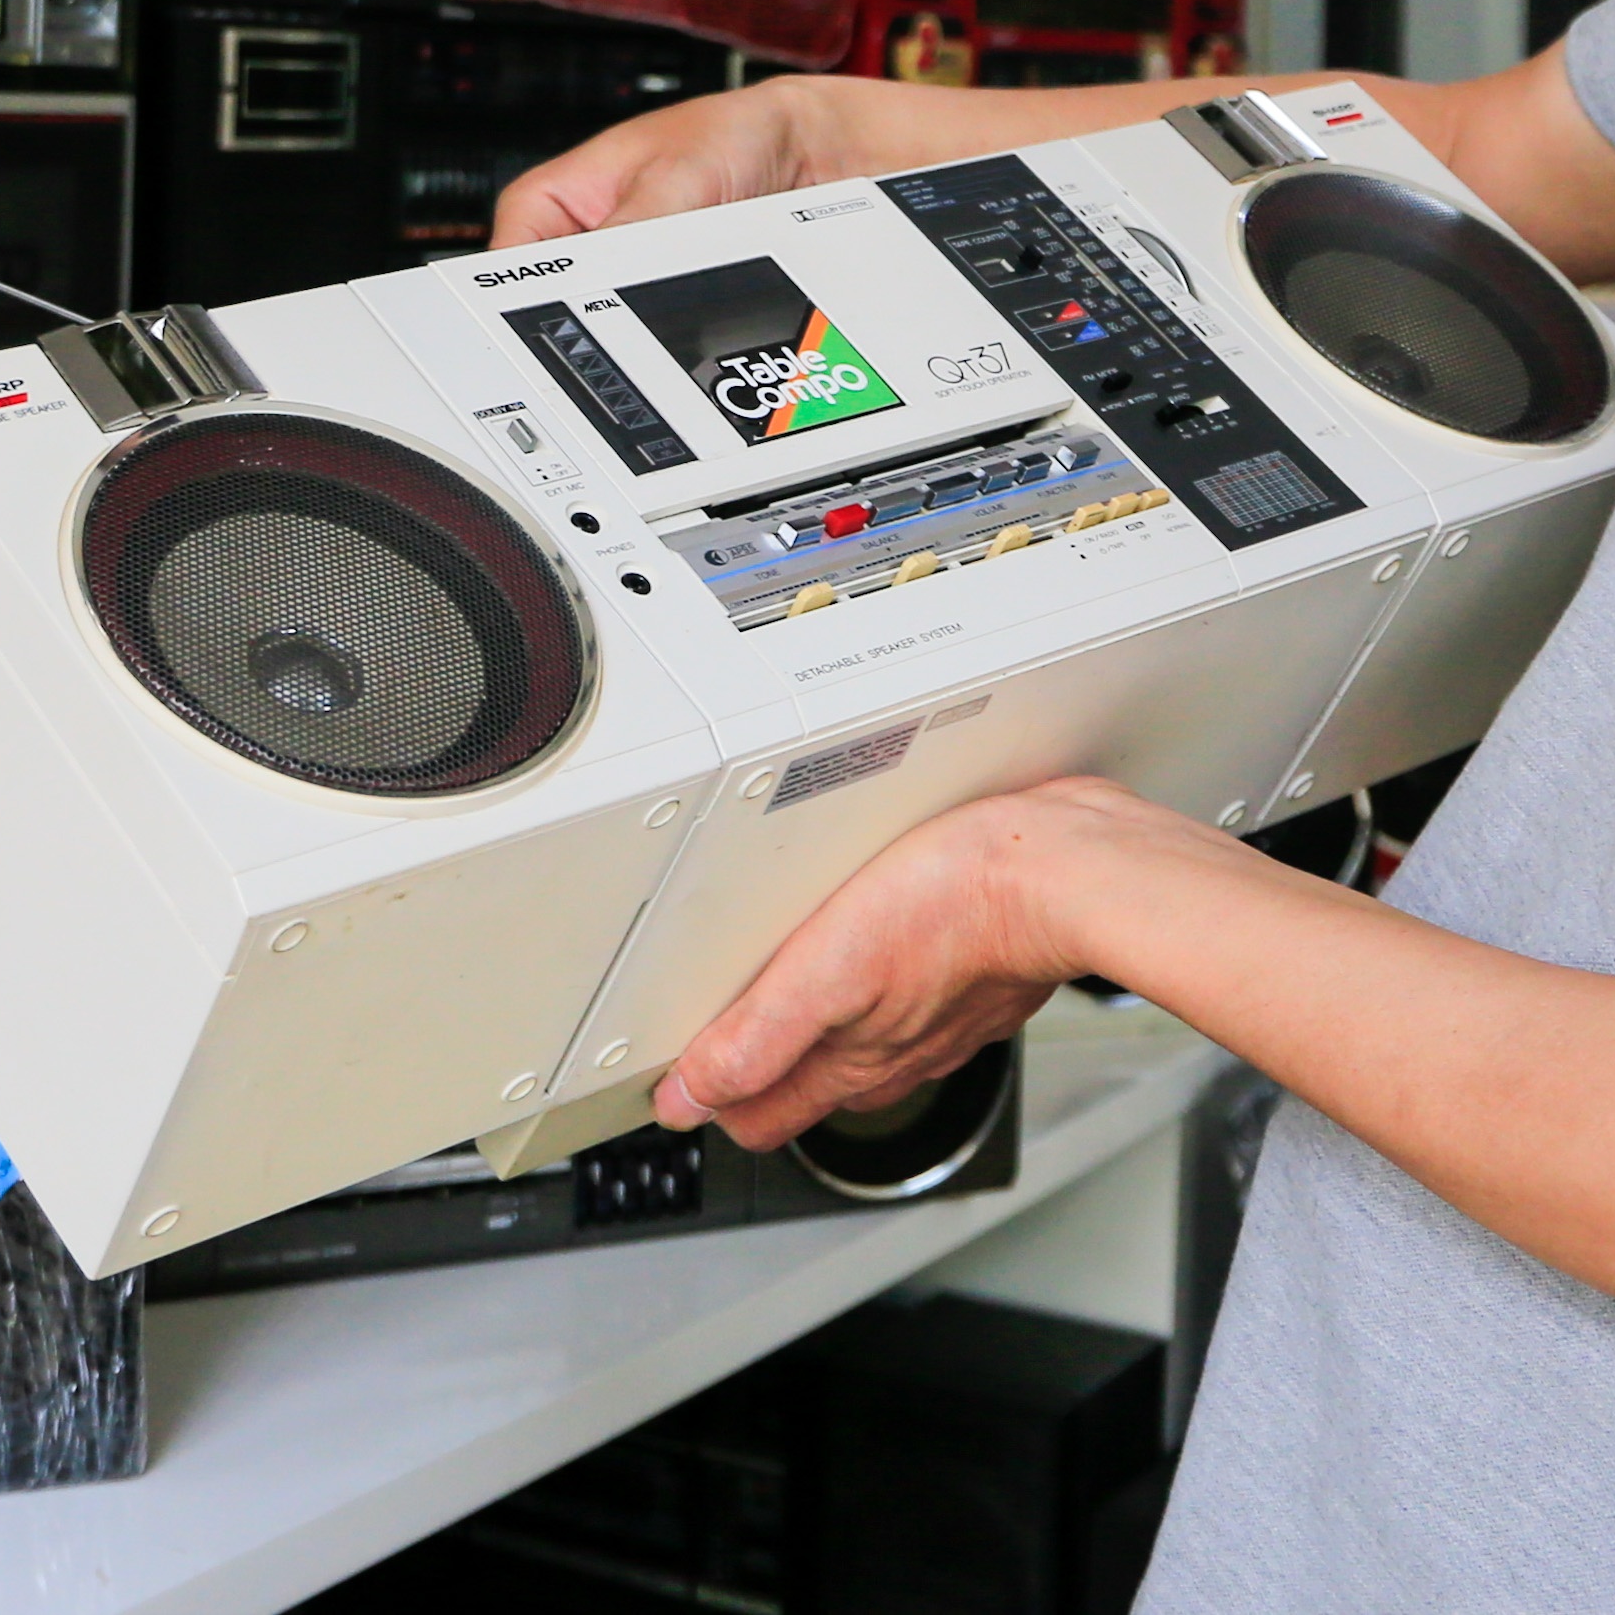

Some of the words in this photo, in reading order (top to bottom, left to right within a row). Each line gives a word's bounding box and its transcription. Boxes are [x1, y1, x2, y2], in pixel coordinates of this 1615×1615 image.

[474, 257, 574, 288] SHARP
[585, 298, 621, 314] METAL
[720, 346, 828, 388] Table
[715, 363, 869, 420] Compo
[13, 400, 68, 419] SPEAKER
[1096, 471, 1119, 482] TAPE
[545, 486, 564, 497] EXT
[566, 482, 585, 492] MIC
[1036, 483, 1078, 498] FUNCTION
[973, 502, 1006, 518] VOLUME
[595, 542, 636, 557] PHONES
[860, 534, 905, 550] BALANCE
[754, 569, 781, 581] TONE
[794, 653, 866, 683] DETACHABLE
[867, 637, 918, 660] SPEAKER
[919, 622, 965, 643] SYSTEM
